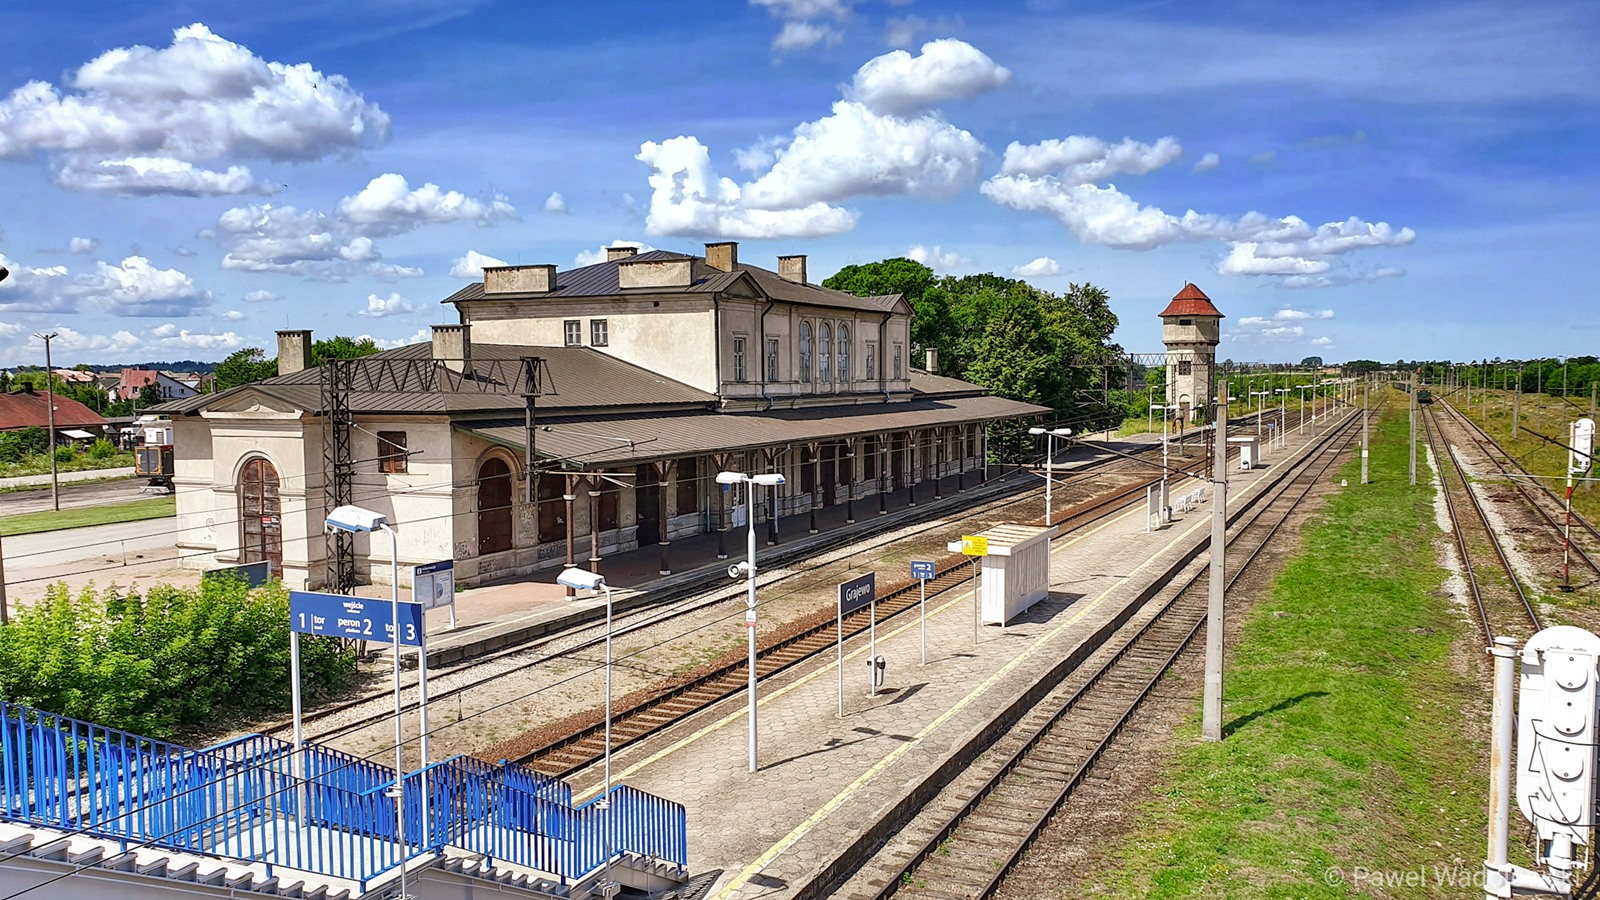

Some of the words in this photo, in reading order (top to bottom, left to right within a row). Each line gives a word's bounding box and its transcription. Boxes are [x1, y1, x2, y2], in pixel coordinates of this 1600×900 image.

[846, 583, 870, 602] Grajewo
[298, 612, 306, 629] 1
[313, 615, 326, 625] tor
[337, 618, 361, 628] peron
[363, 618, 373, 636] 2
[385, 623, 394, 632] to
[406, 623, 416, 641] 3
